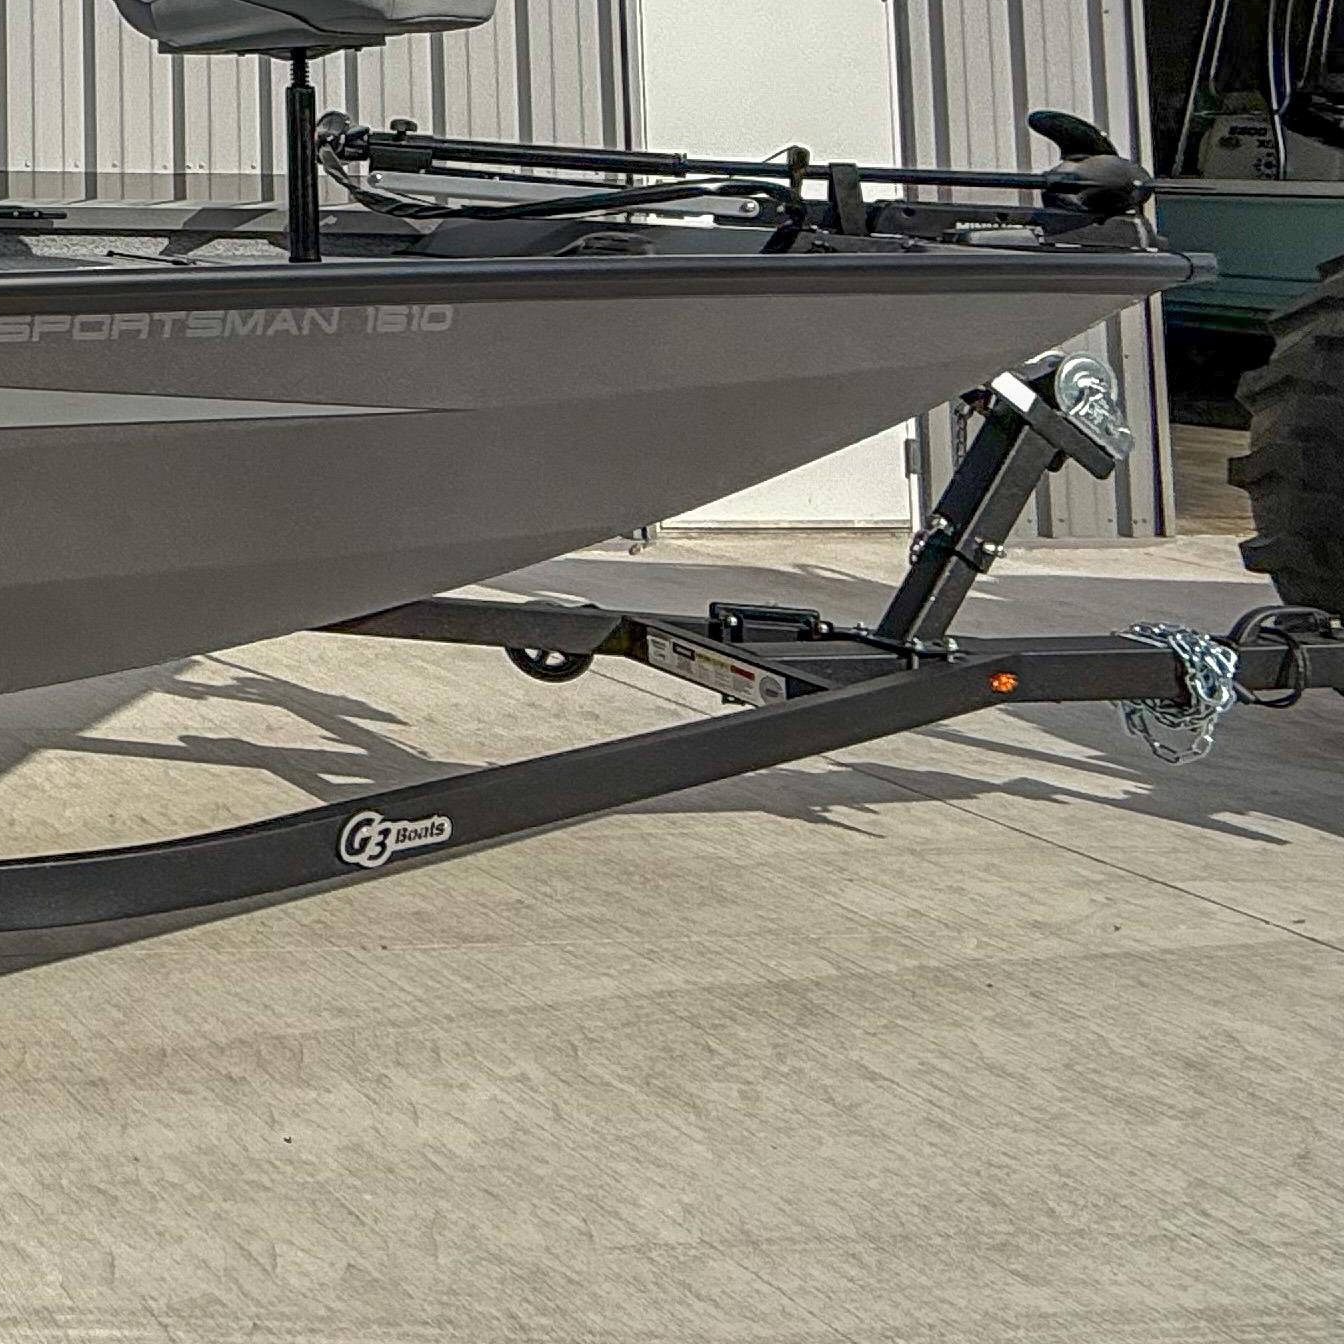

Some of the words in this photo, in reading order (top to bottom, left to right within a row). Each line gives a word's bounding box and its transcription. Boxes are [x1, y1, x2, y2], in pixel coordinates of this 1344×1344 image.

[366, 303, 455, 335] 1610
[345, 817, 391, 861] G3
[395, 821, 445, 844] Boats
